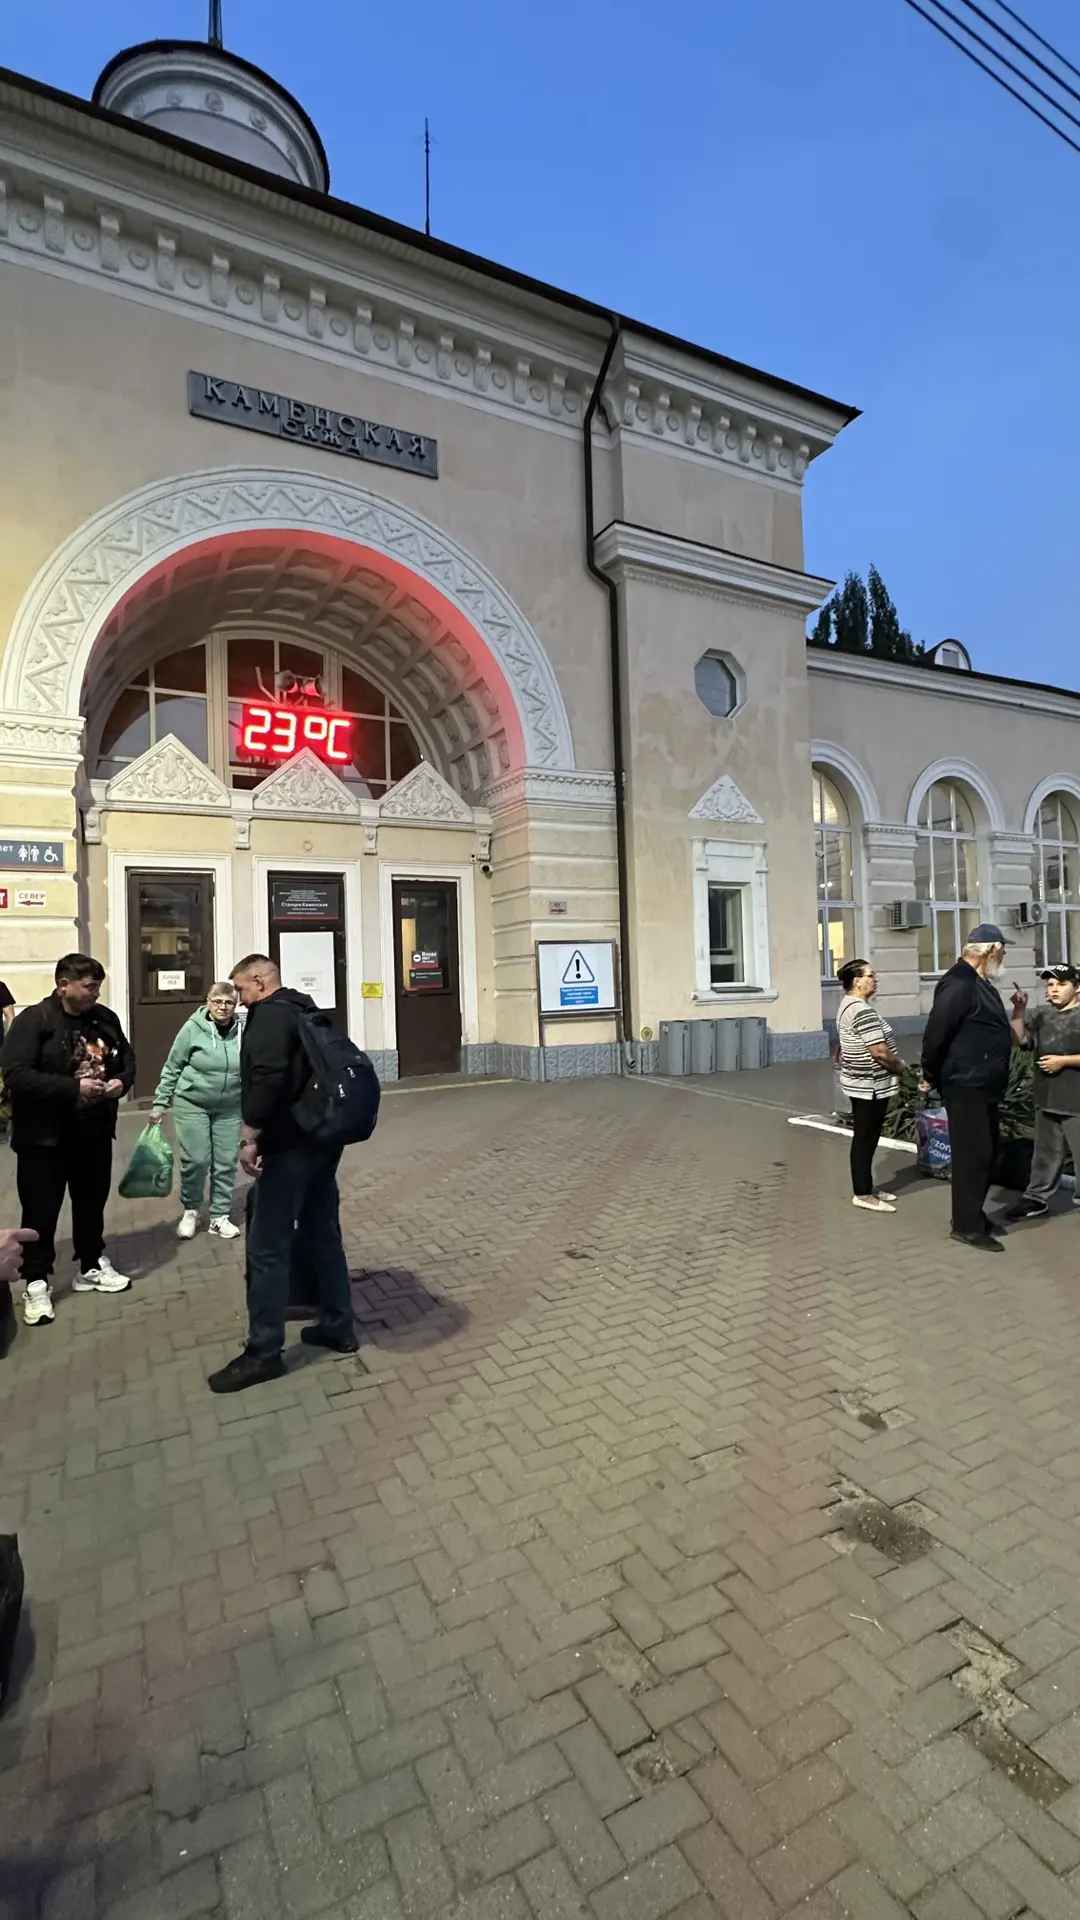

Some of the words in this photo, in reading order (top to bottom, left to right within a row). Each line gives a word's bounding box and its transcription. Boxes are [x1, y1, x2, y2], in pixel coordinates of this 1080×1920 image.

[203, 376, 426, 459] КАМЕНСКАЯ
[282, 419, 361, 456] СКЖД
[18, 892, 46, 900] СЕВЕР
